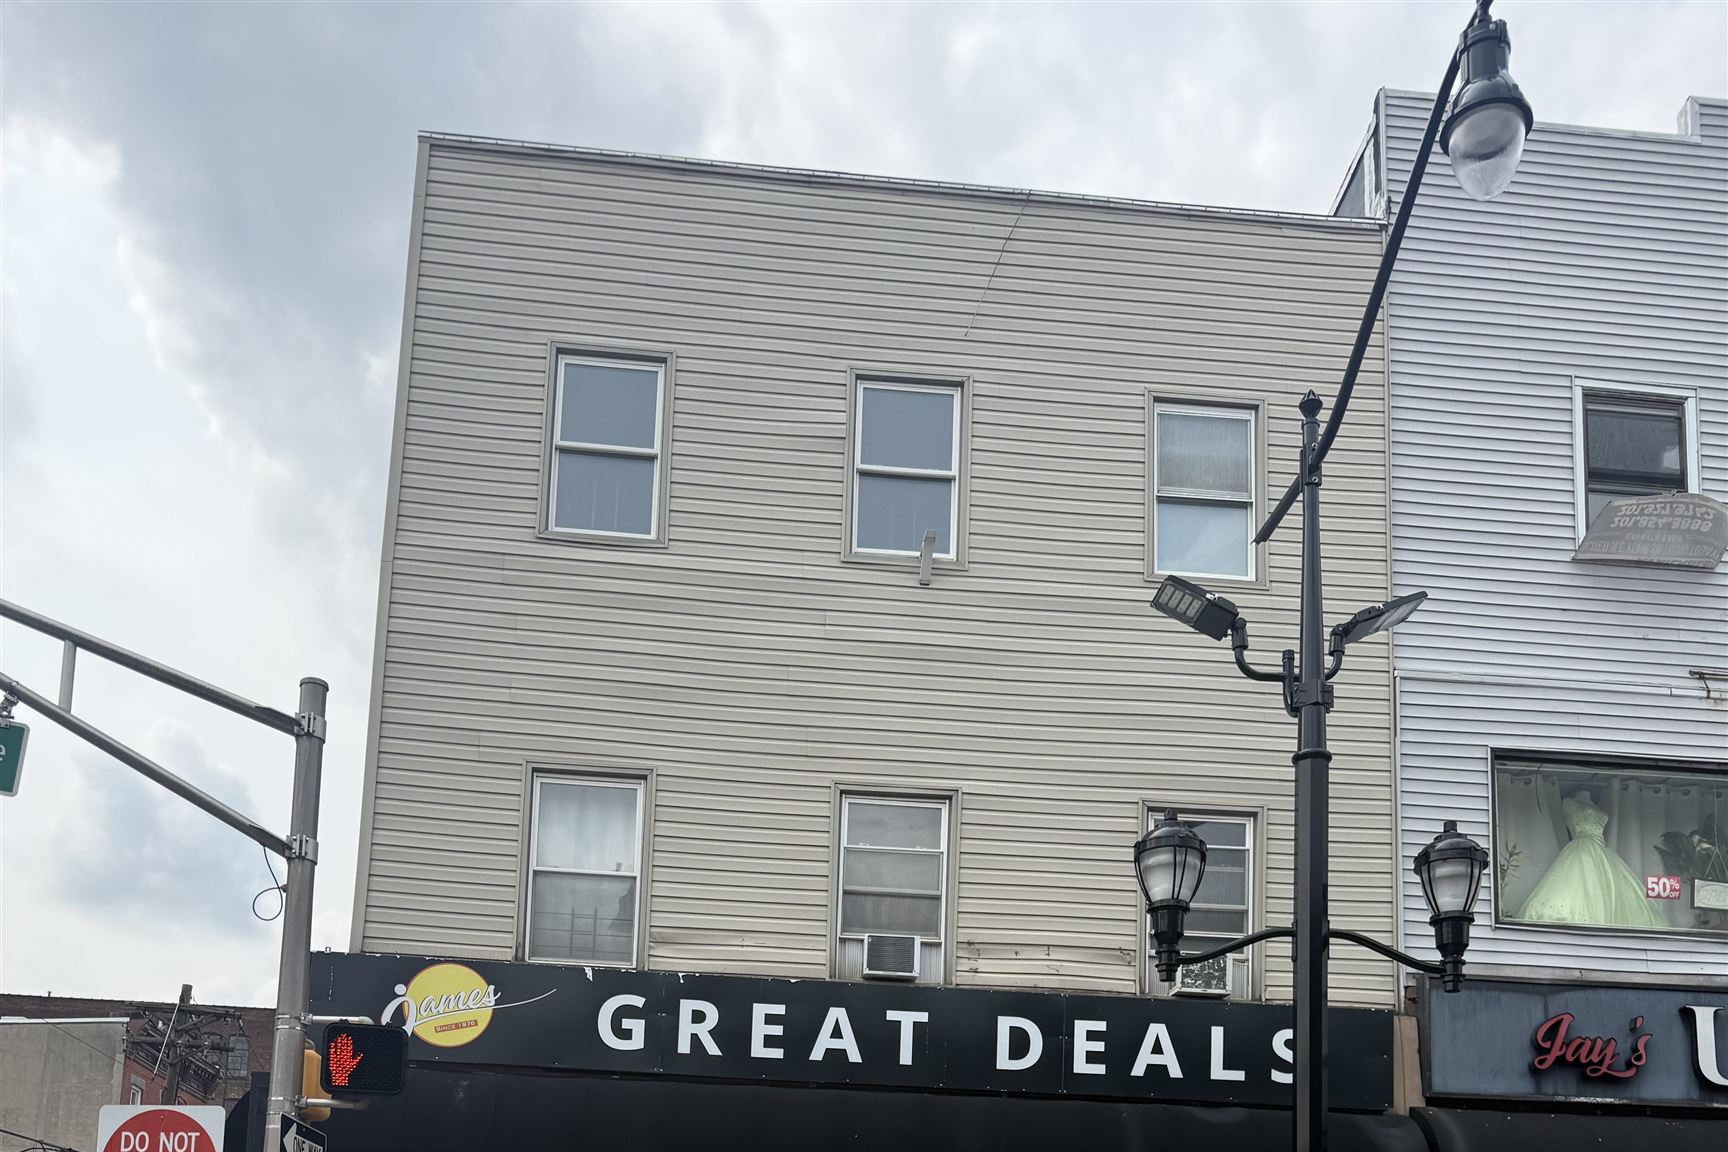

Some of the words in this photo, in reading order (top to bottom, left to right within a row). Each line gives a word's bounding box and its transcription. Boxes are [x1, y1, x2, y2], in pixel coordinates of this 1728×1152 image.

[1647, 877, 1680, 897] 50%
[597, 993, 929, 1067] GREAT
[995, 1015, 1294, 1085] DEALS
[1533, 1011, 1654, 1079] Jay's
